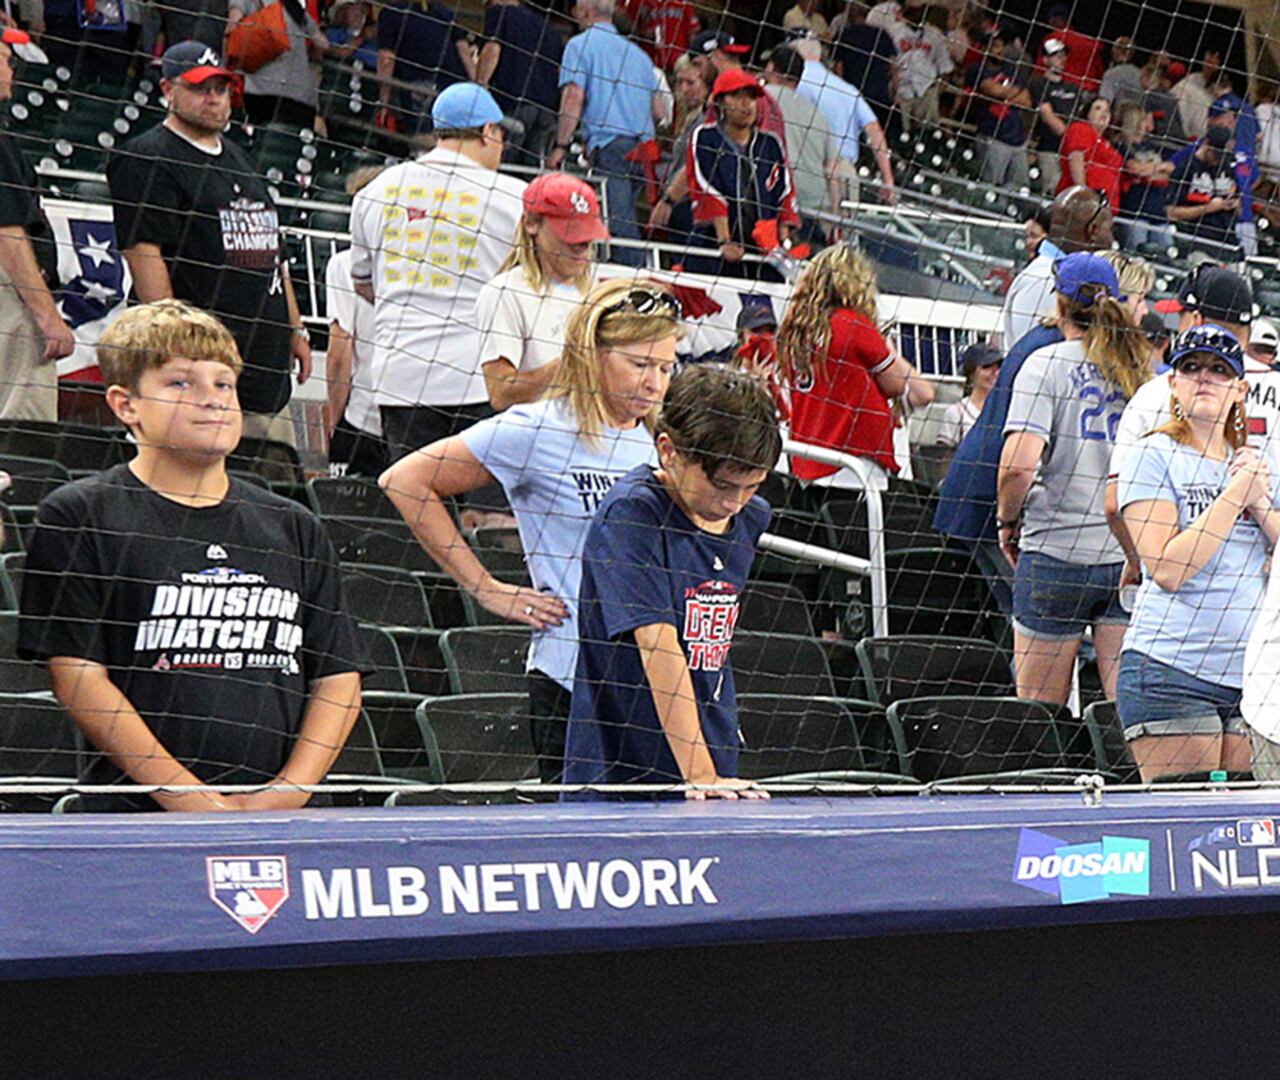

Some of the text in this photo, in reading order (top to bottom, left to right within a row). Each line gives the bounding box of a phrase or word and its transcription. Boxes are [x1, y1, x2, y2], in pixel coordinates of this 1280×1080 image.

[151, 585, 299, 620] DIVISION
[134, 617, 268, 651] MATCH
[213, 861, 283, 882] MLB
[1016, 851, 1146, 880] DOOSAN
[303, 857, 718, 919] MLB NETWORK
